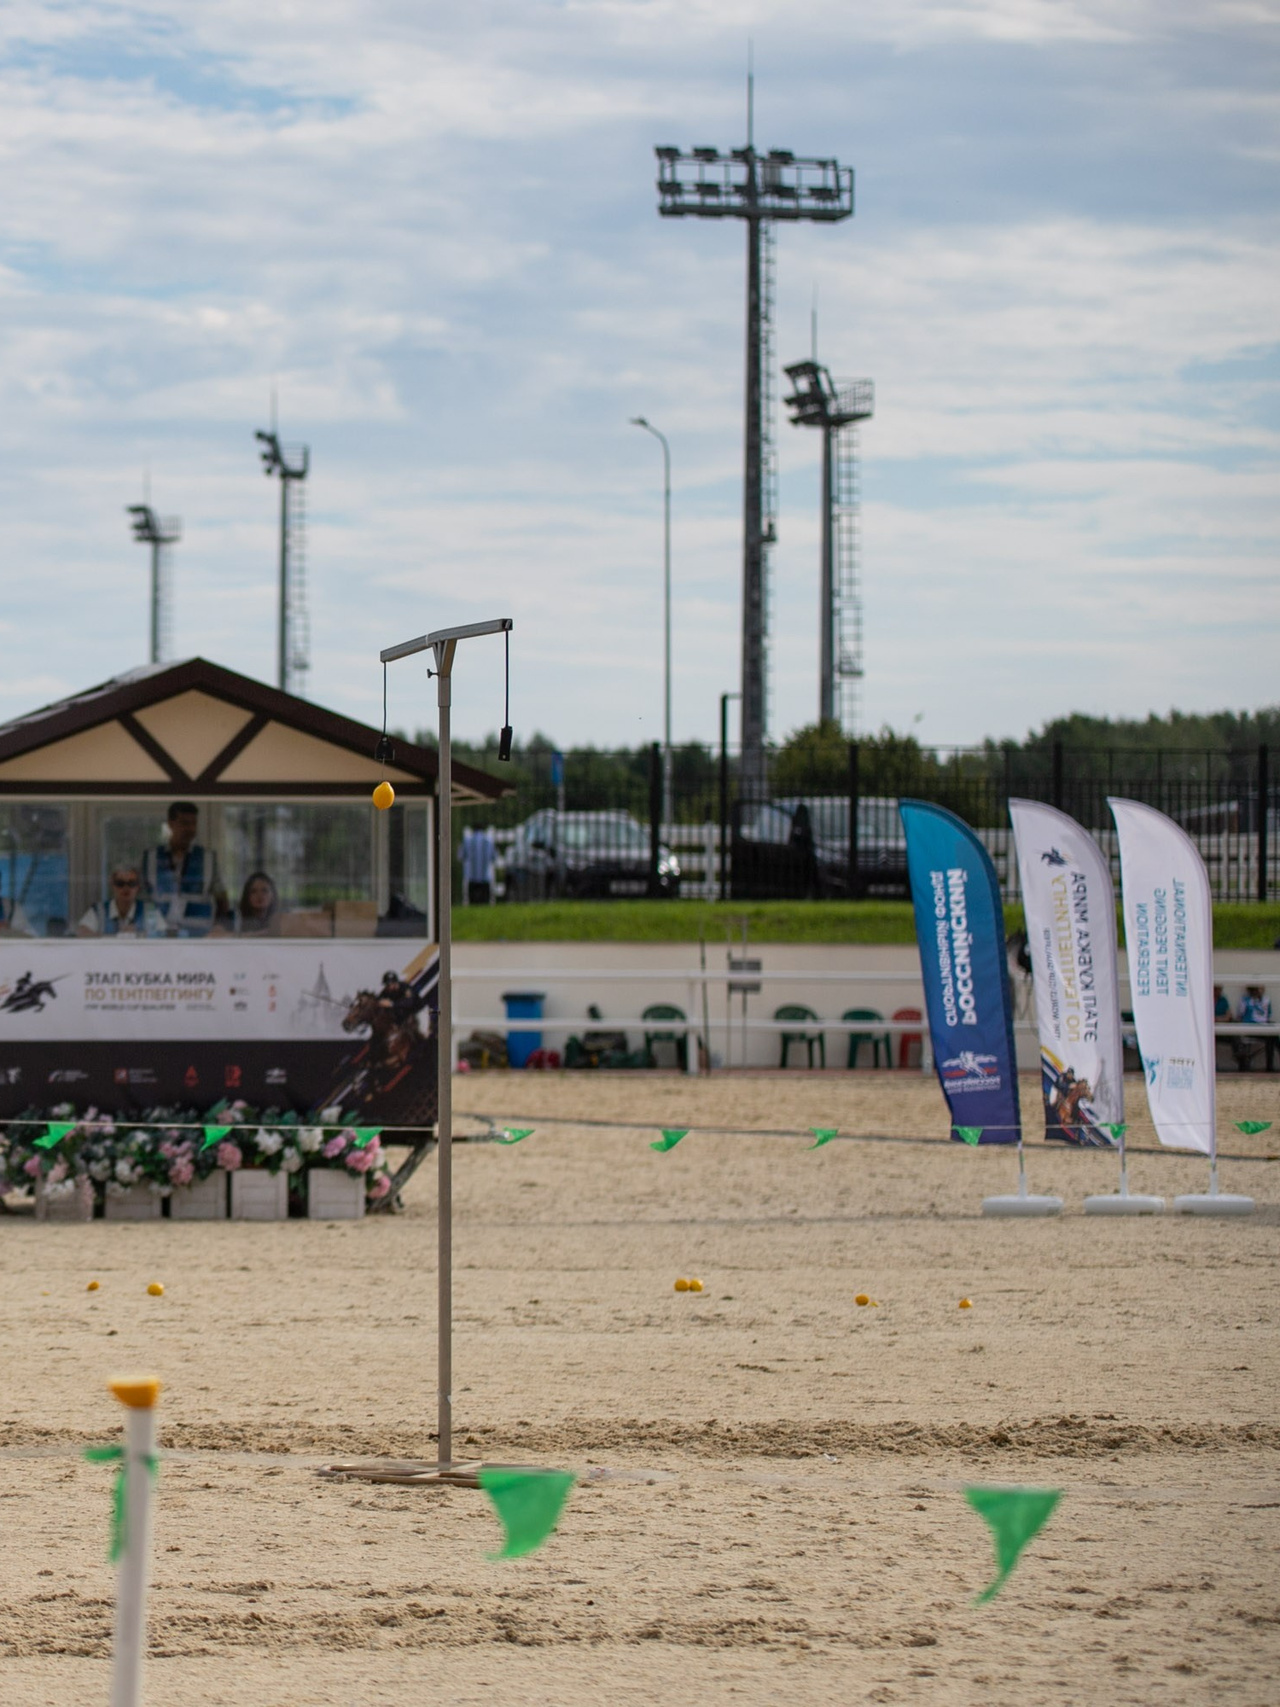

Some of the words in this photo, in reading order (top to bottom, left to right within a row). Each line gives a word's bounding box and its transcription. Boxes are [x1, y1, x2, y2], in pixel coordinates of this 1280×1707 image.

[84, 973, 120, 985] ЭТАП
[124, 973, 170, 985] КУБКА
[176, 973, 216, 985] МИРА
[84, 988, 106, 1001] ПО
[110, 988, 215, 1001] ТЕНТПЕГГИНГУ
